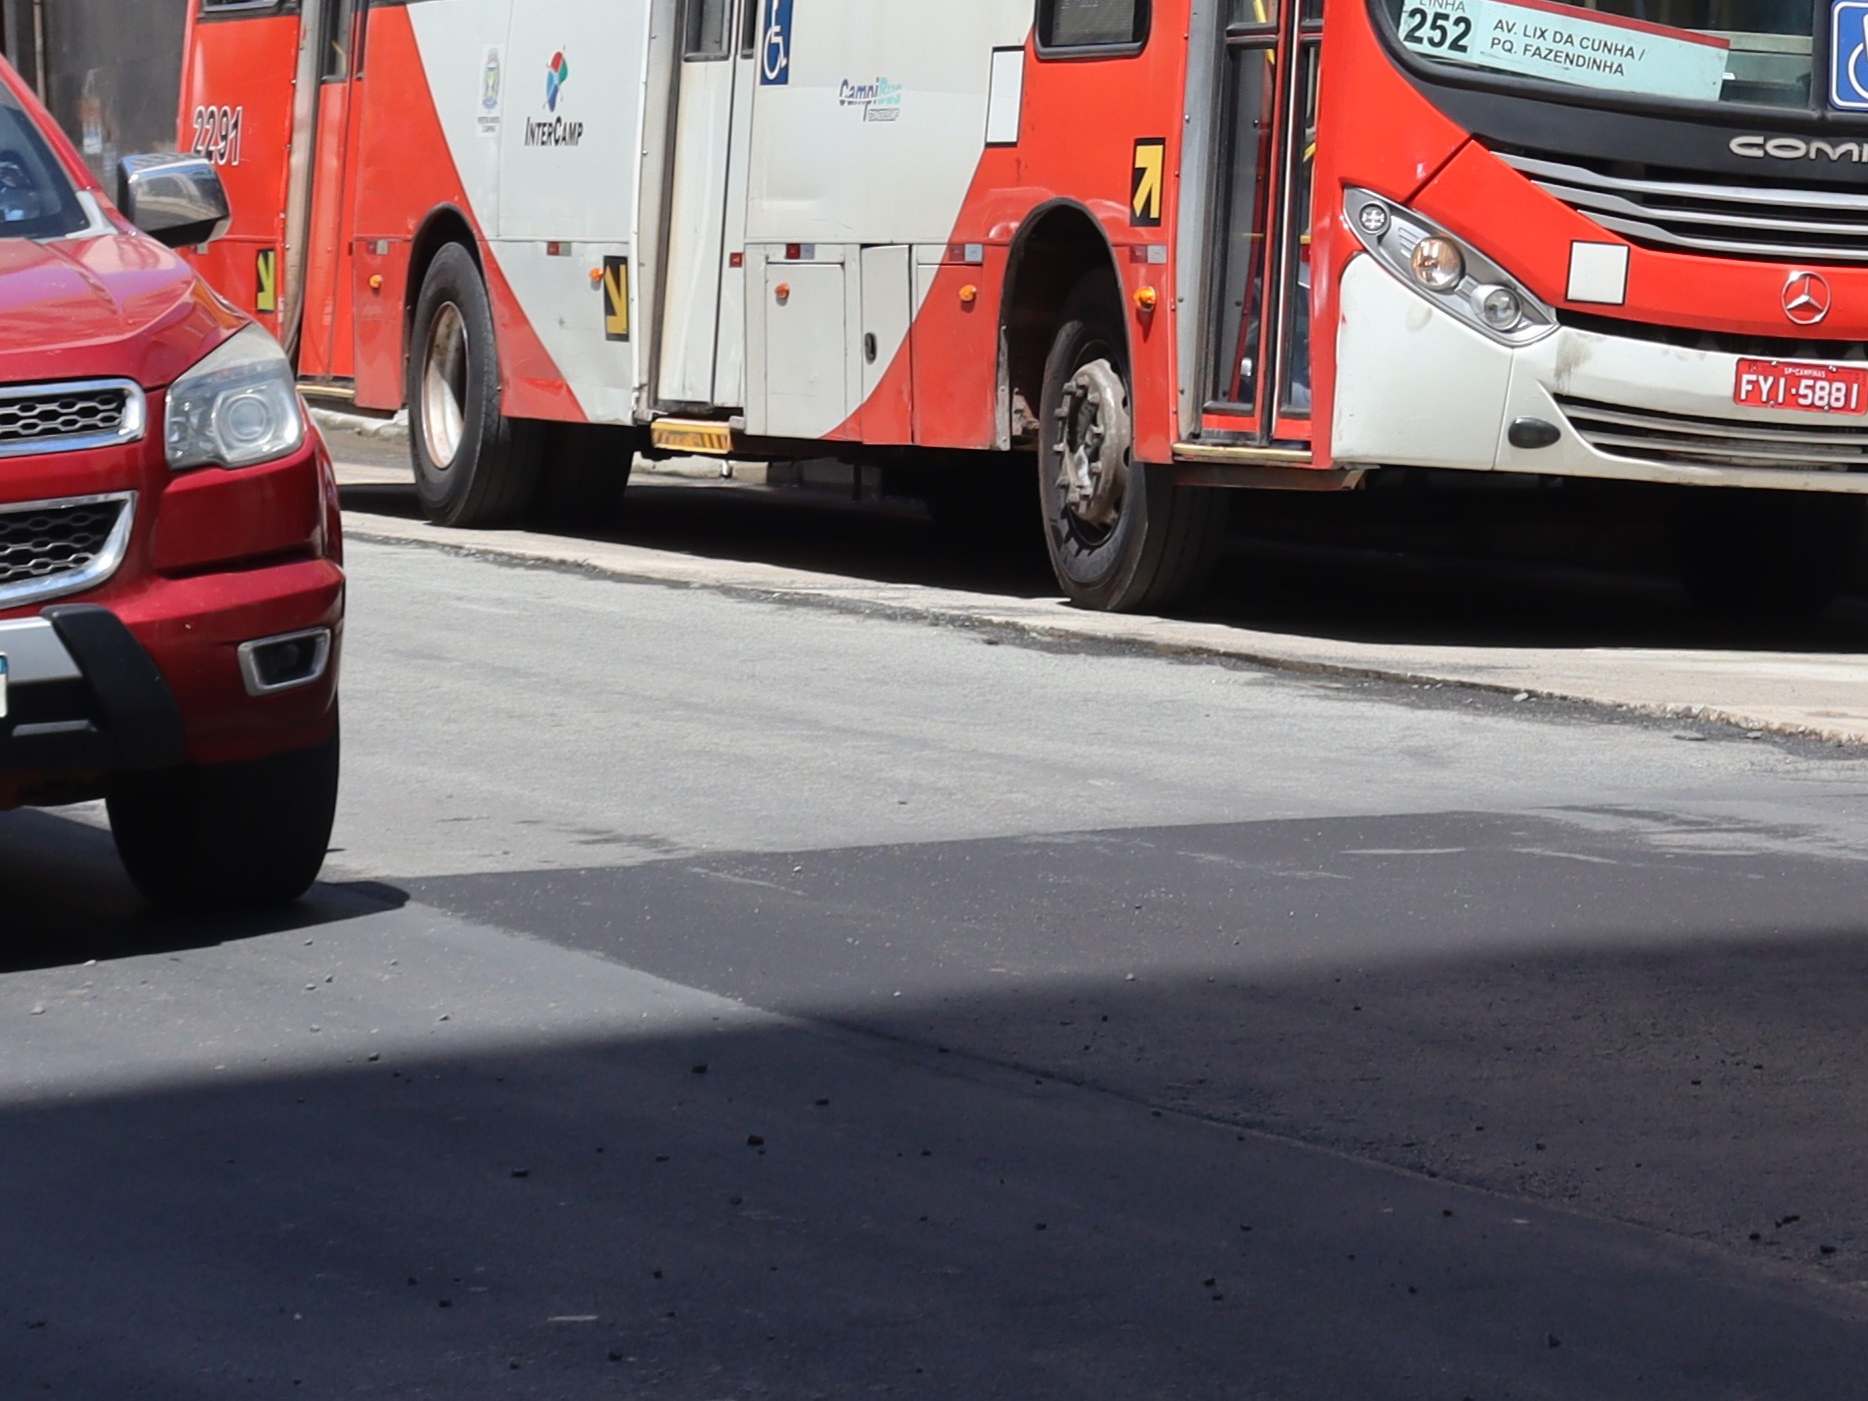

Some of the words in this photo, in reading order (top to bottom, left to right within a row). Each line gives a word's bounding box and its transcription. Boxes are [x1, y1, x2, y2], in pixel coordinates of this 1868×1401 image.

[1403, 7, 1472, 53] 252
[1493, 18, 1518, 36] AV.
[1523, 24, 1548, 42] LIX
[1549, 31, 1574, 48] DA
[1579, 36, 1635, 60] CUNHA
[1490, 37, 1517, 55] PQ.
[1523, 43, 1625, 76] FAZENDINHA
[192, 105, 243, 166] 2291
